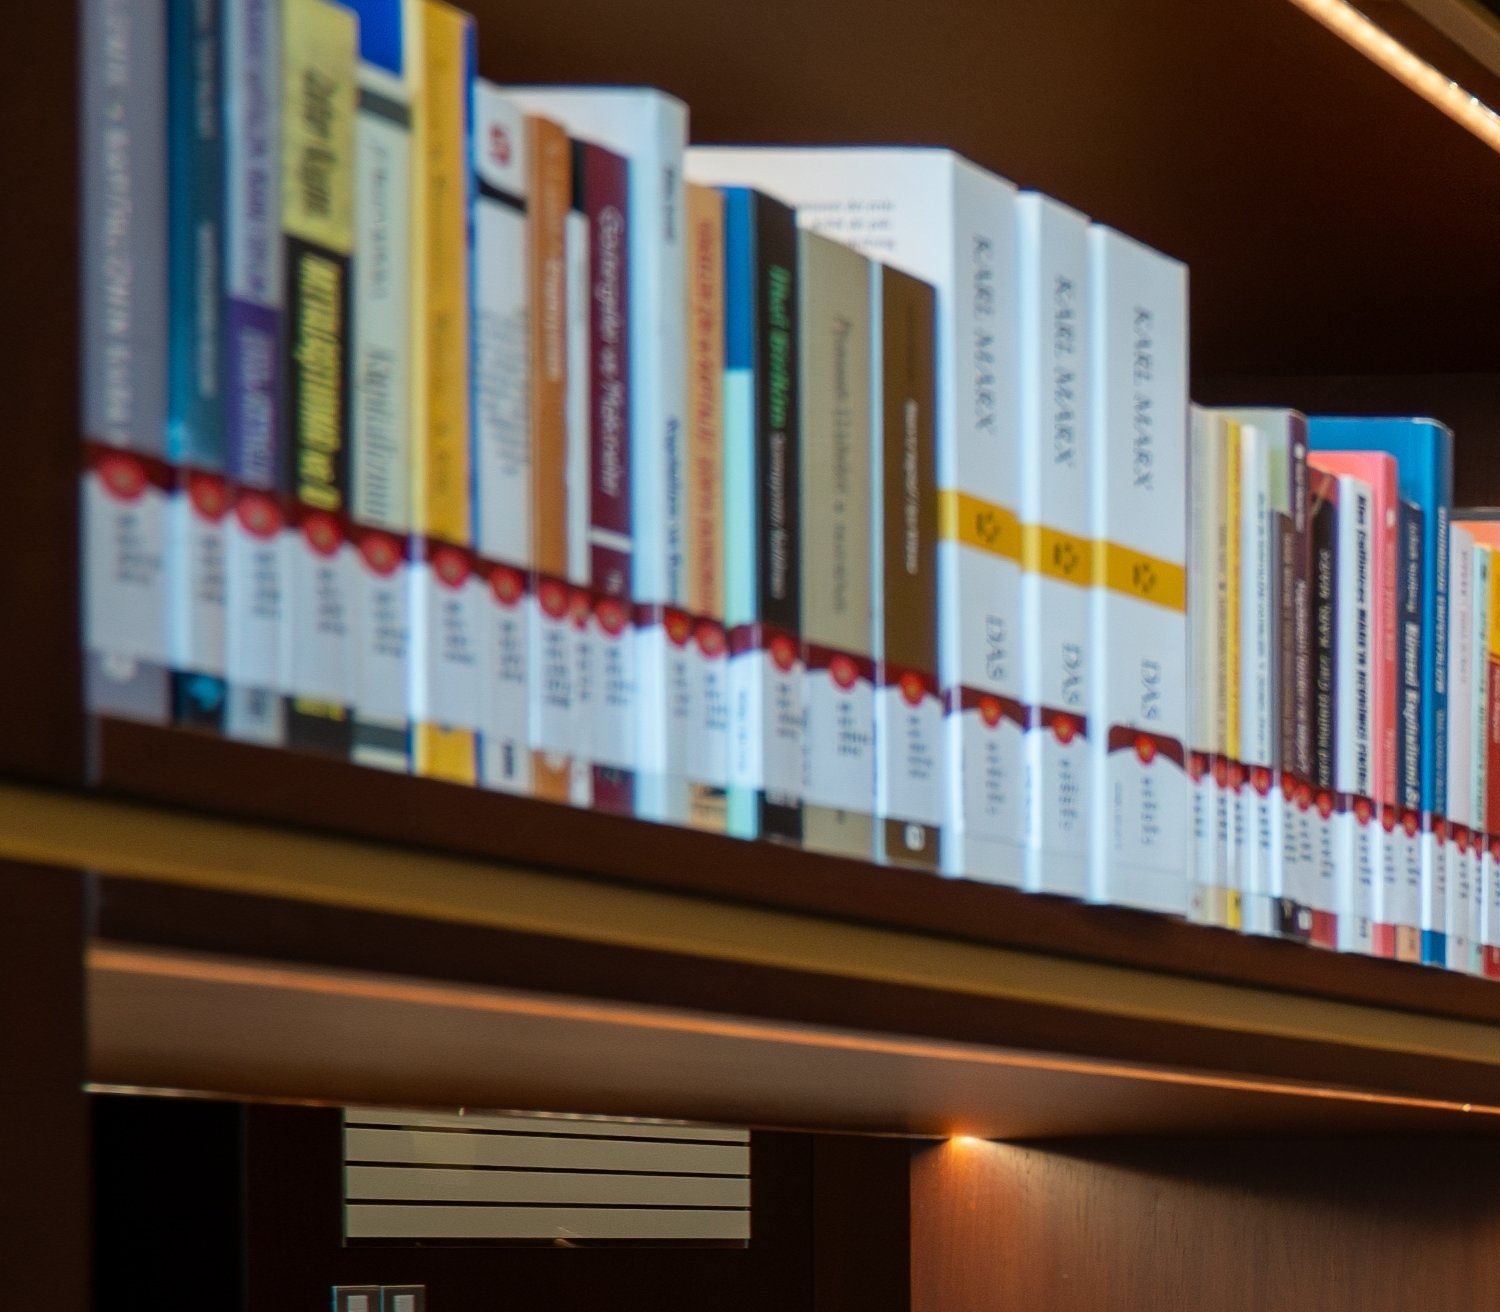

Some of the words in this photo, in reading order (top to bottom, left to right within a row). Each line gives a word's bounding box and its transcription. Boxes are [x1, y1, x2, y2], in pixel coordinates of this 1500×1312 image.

[972, 236, 996, 316] KARL
[1053, 275, 1077, 357] KARL
[974, 328, 999, 436] MARX
[1133, 306, 1154, 383] KARL
[1054, 365, 1078, 470] MARX
[1132, 393, 1155, 493] MARX
[985, 614, 1008, 683] DAS
[1061, 642, 1084, 706] DAS
[1140, 659, 1161, 722] DAS
